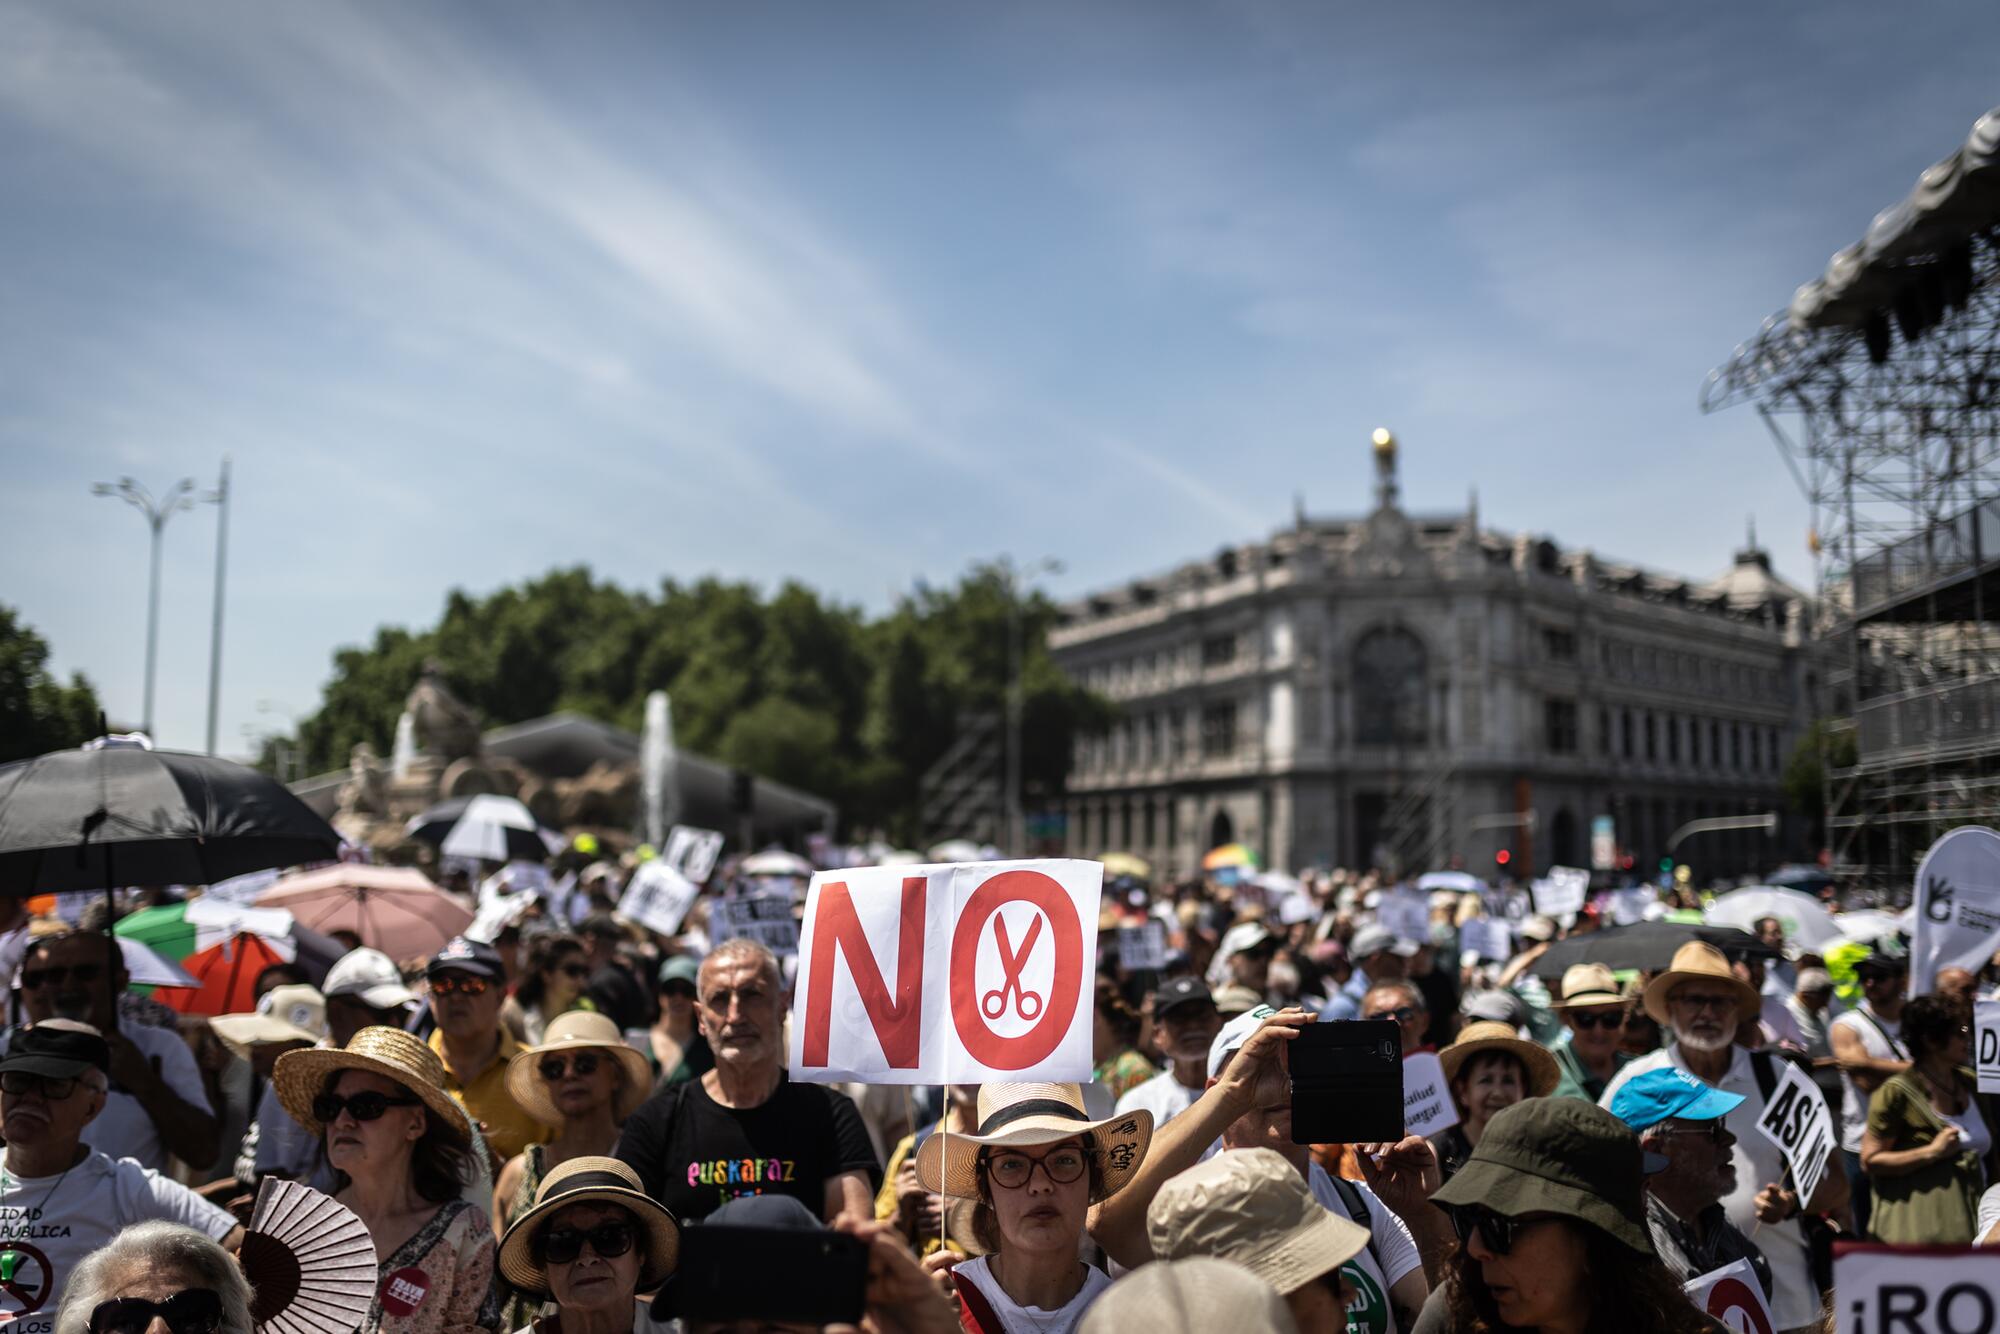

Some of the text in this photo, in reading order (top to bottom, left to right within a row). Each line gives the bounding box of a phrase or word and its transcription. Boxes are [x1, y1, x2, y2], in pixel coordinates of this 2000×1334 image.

[802, 869, 1083, 1071] NO
[686, 1158, 796, 1188] euskaraz
[1798, 1126, 1827, 1197] NO
[17, 1321, 52, 1334] LOS
